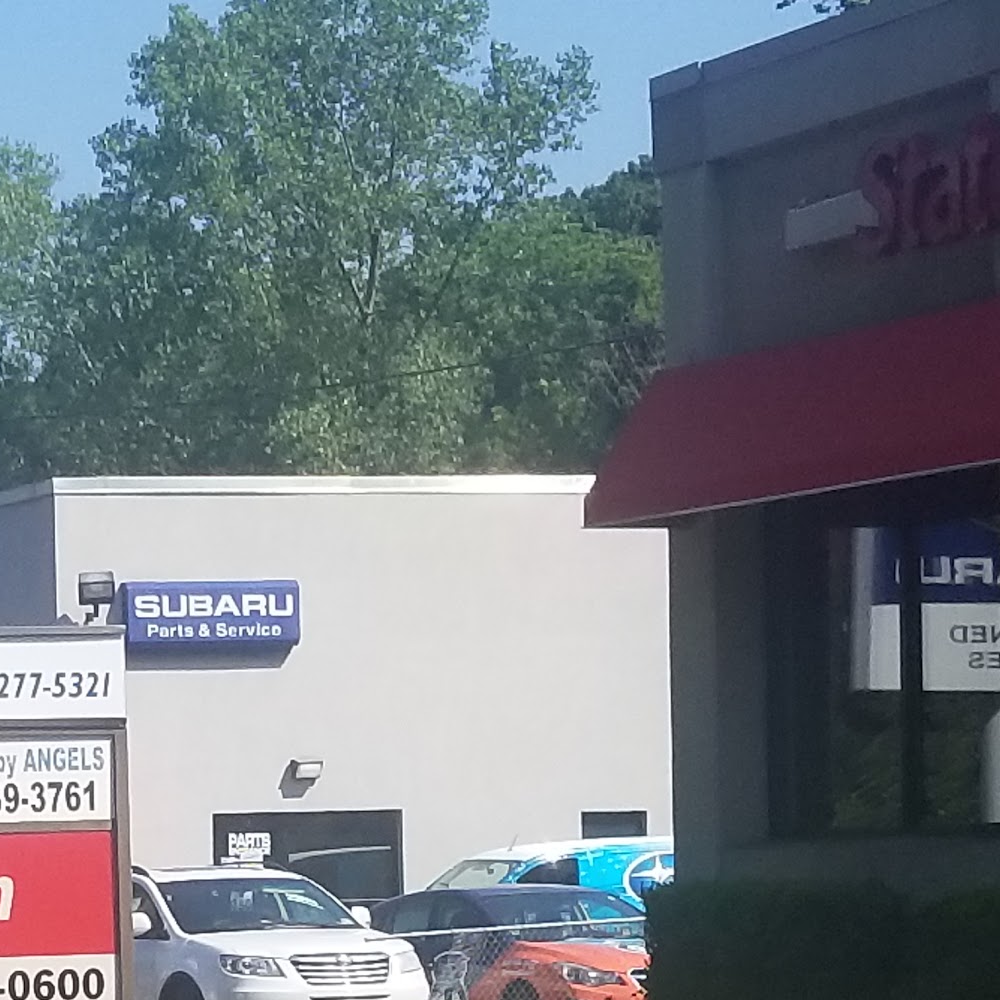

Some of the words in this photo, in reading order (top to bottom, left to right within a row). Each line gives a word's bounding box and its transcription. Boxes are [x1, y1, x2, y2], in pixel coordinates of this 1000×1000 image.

[134, 594, 294, 618] SUBARU
[147, 624, 193, 637] Parts
[198, 623, 211, 637] &
[216, 621, 282, 637] Service
[24, 747, 105, 772] ANGELS
